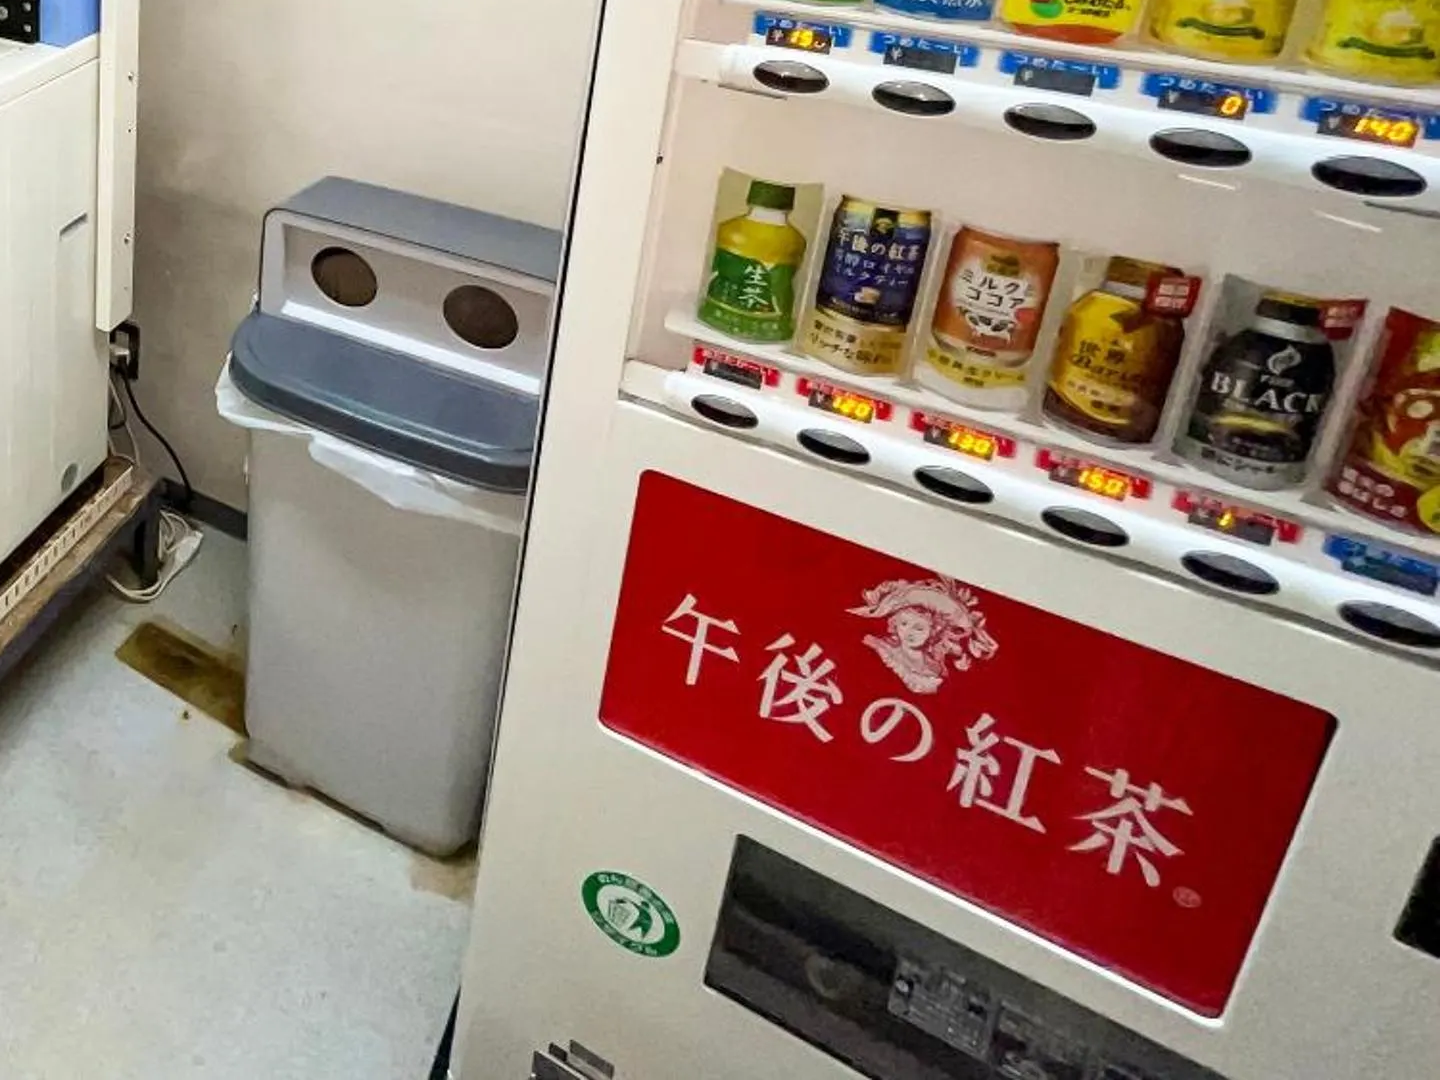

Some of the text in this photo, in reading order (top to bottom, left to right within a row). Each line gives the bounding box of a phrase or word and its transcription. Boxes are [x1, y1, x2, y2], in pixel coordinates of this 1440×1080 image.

[738, 264, 770, 309] 生茶
[960, 268, 1021, 295] ミルク
[965, 286, 1025, 309] ココア
[1211, 371, 1324, 414] BLACK
[662, 593, 1194, 888] 午後の紅茶
